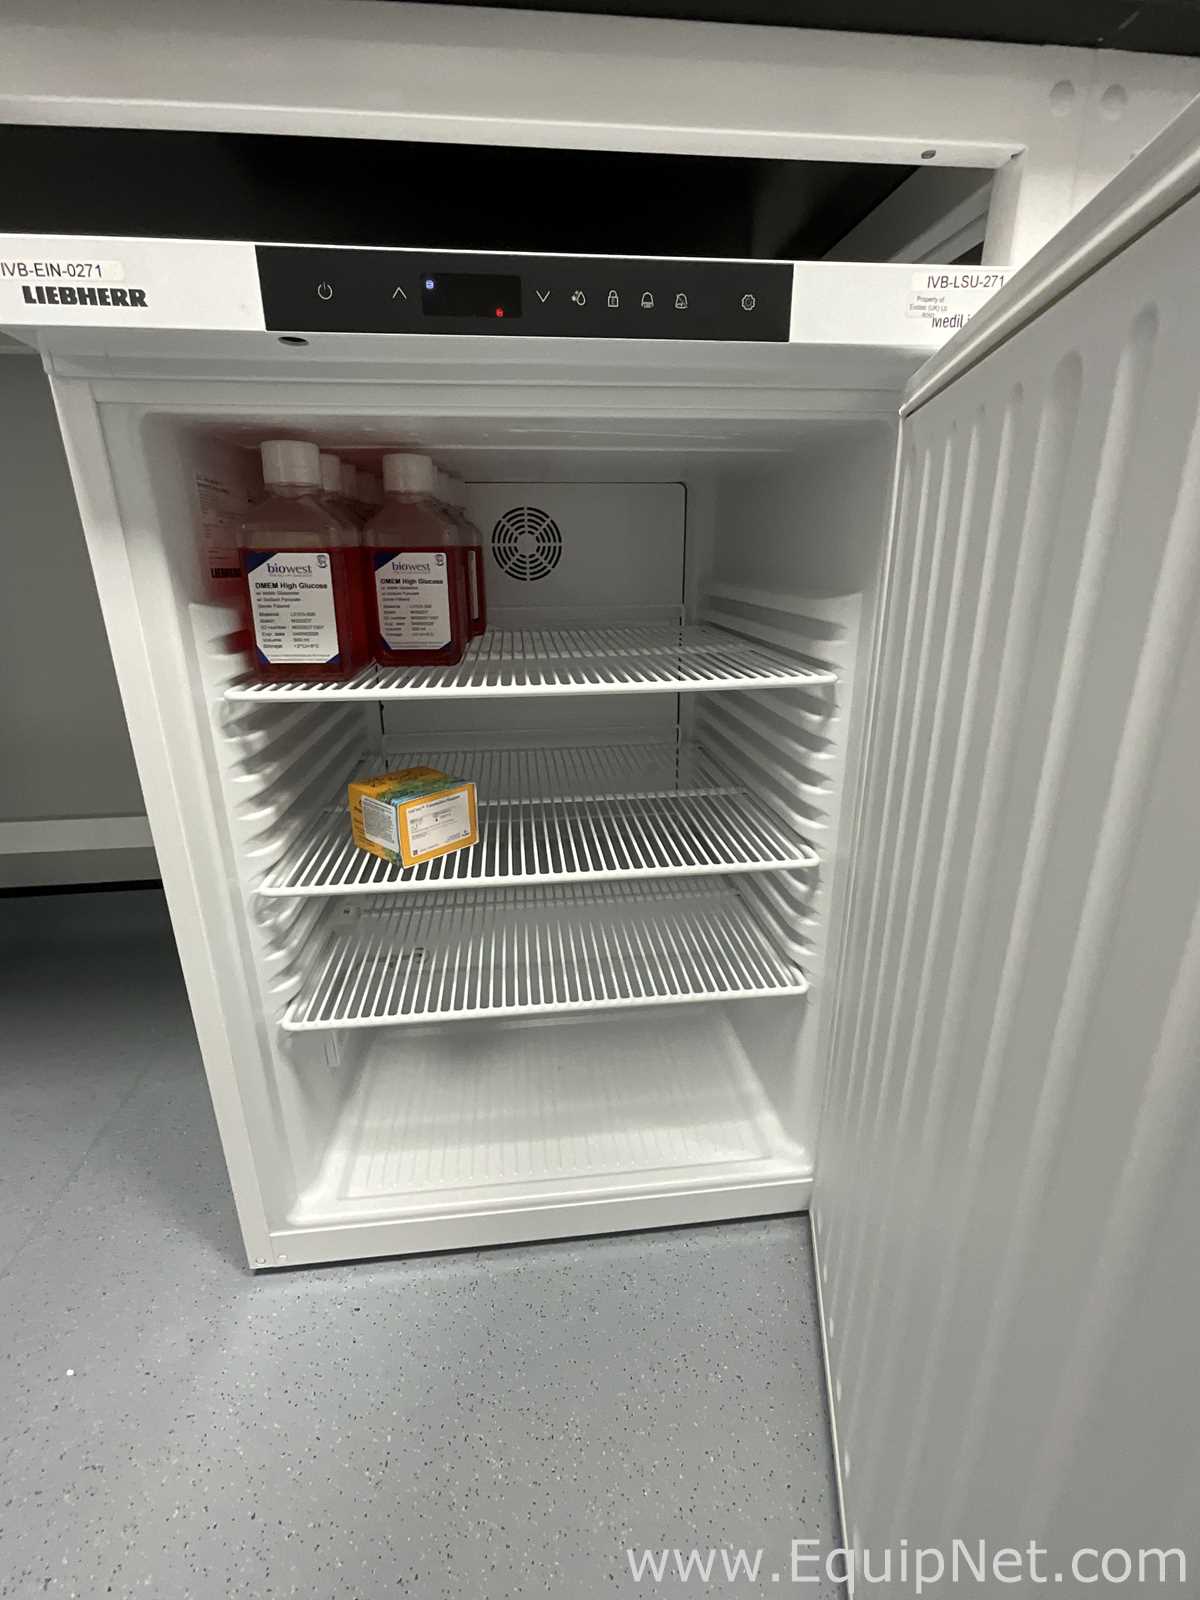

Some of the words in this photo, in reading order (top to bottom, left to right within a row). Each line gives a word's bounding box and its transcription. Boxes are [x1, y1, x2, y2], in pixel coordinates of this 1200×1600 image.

[1, 262, 102, 278] IVB-EIN-0271
[927, 275, 1005, 289] IVB-LSU-271
[22, 285, 148, 307] LIEBHERR
[267, 563, 312, 573] biowest
[391, 562, 431, 572] biowest
[280, 582, 298, 590] High
[402, 578, 417, 586] High
